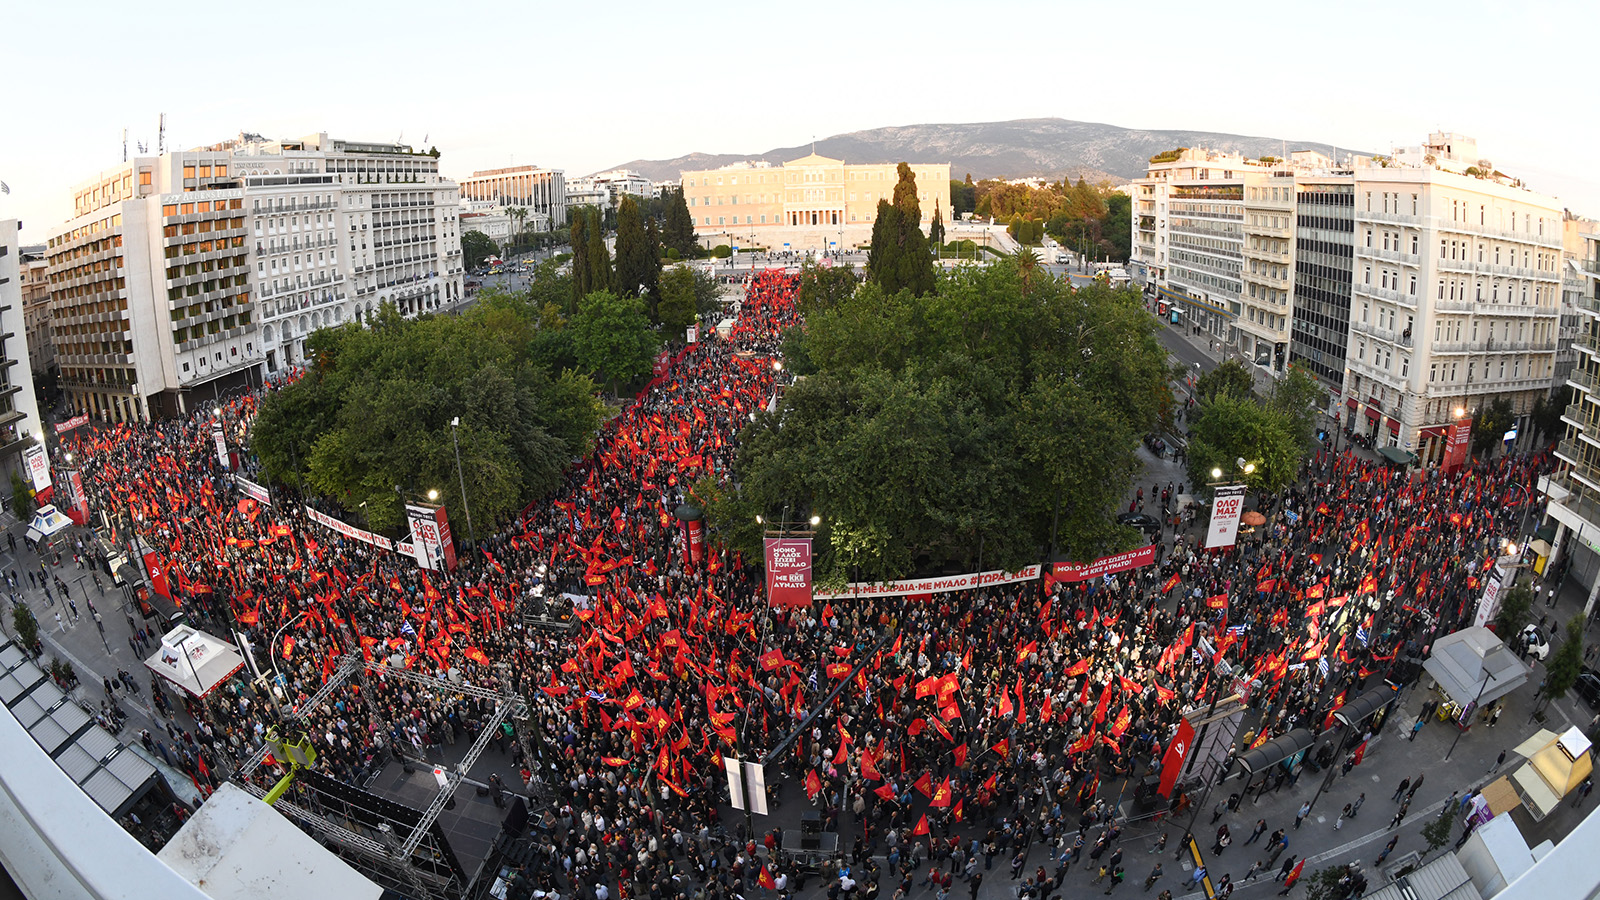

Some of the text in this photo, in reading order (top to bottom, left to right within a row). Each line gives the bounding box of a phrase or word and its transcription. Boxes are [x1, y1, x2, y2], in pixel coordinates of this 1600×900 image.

[1217, 499, 1239, 507] ΟΛΟΙ
[1216, 507, 1237, 515] ΜΑΣ
[399, 543, 414, 554] ΛΑΟ
[1137, 549, 1151, 557] ΛΑΟ
[1090, 566, 1102, 574] ΚΚΕ
[1104, 560, 1132, 570] ΔΥΝΑΤΟ!
[934, 578, 967, 590] ΜΥΑΛΟ
